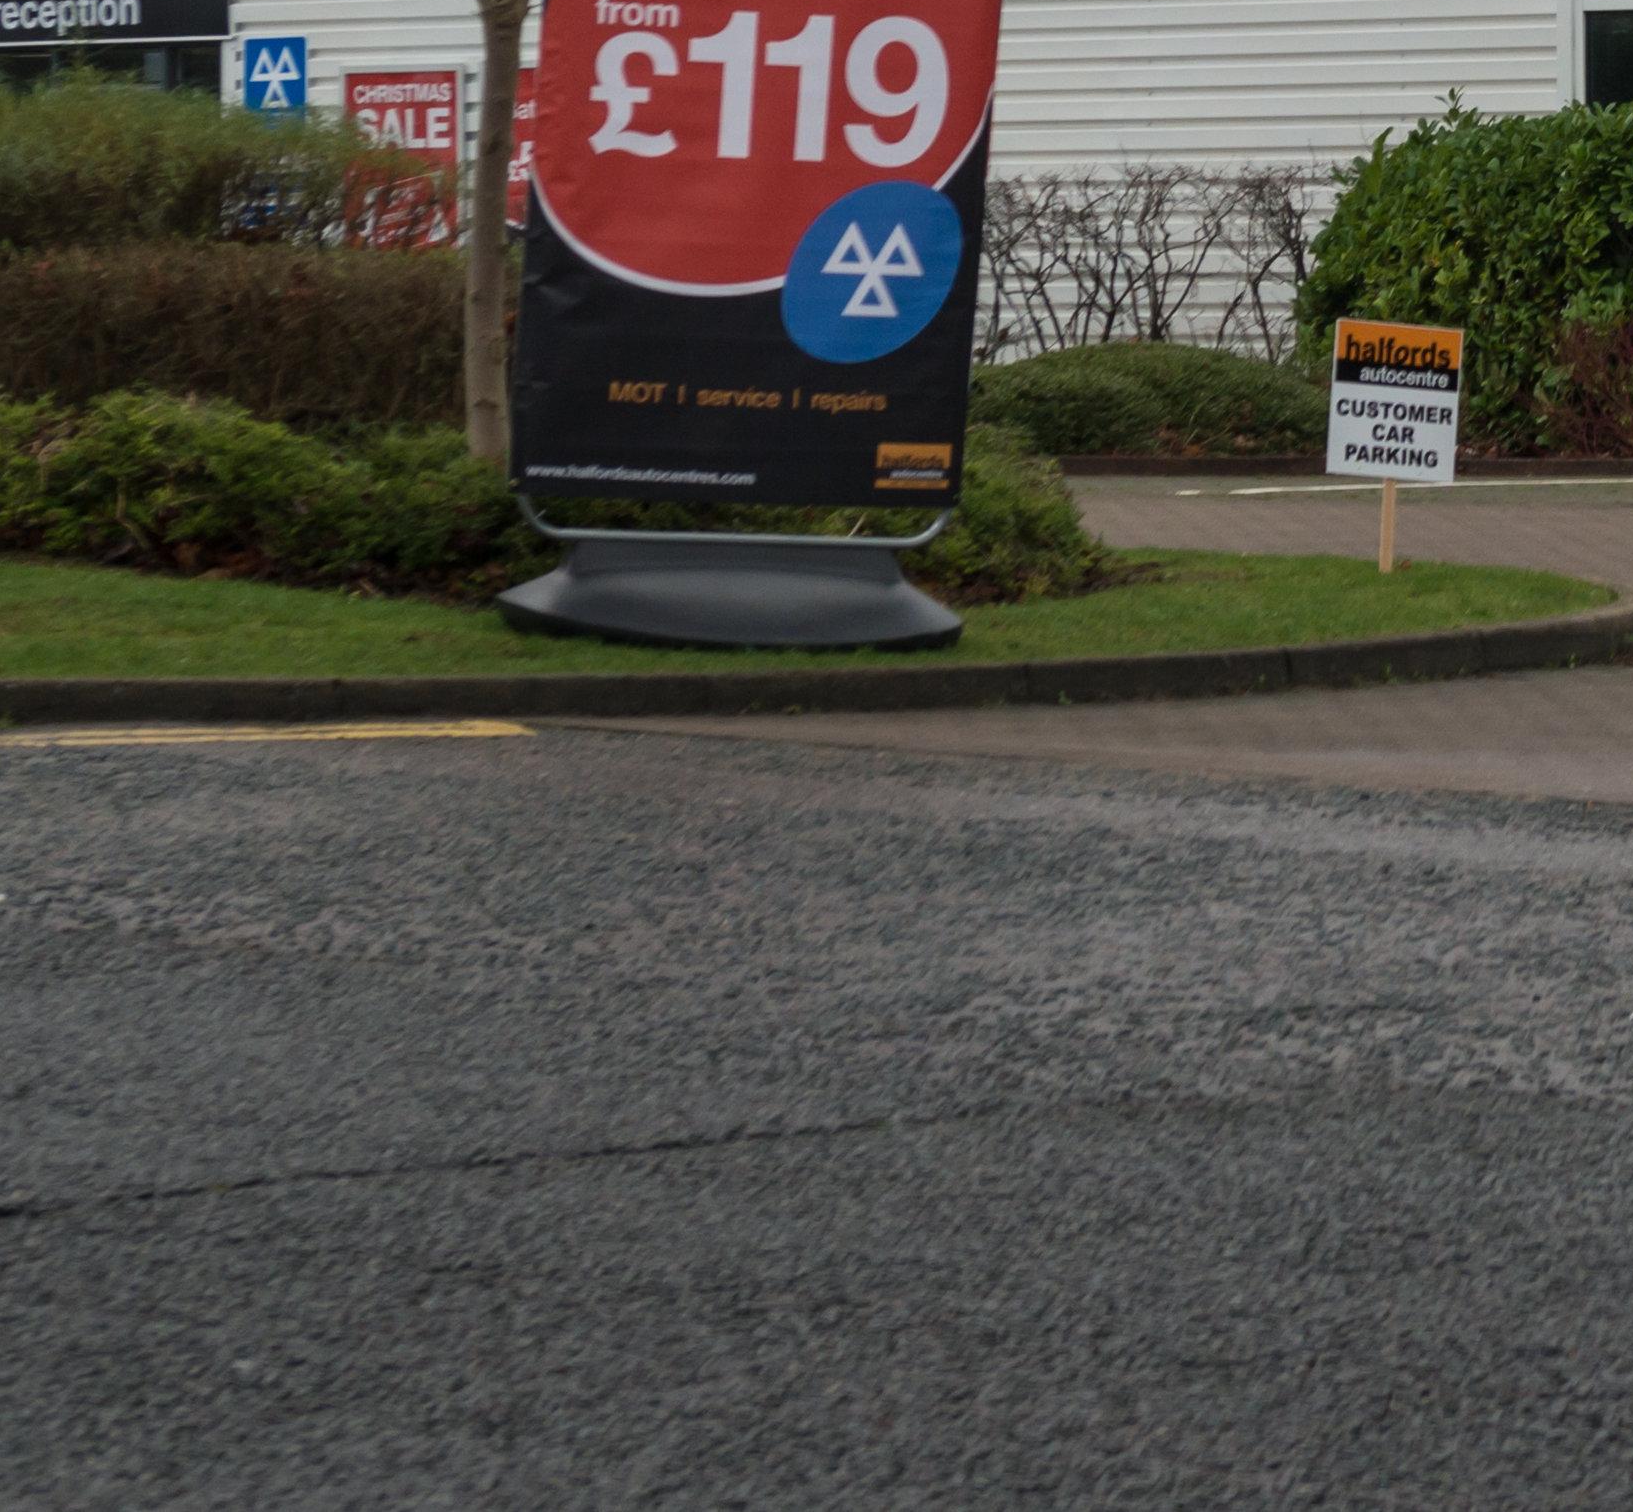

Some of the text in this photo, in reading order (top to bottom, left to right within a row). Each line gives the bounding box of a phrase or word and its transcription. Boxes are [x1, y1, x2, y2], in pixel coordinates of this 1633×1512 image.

[352, 82, 452, 104] CHRISTMAS
[588, 9, 950, 168] £119
[354, 107, 452, 150] SALE
[1345, 333, 1451, 369] halfords
[1359, 364, 1450, 389] autocentre
[608, 380, 888, 416] MOT service repairs
[1335, 397, 1453, 426] CUSTOMER
[1371, 423, 1415, 445] CAR
[1343, 443, 1438, 469] PARKING
